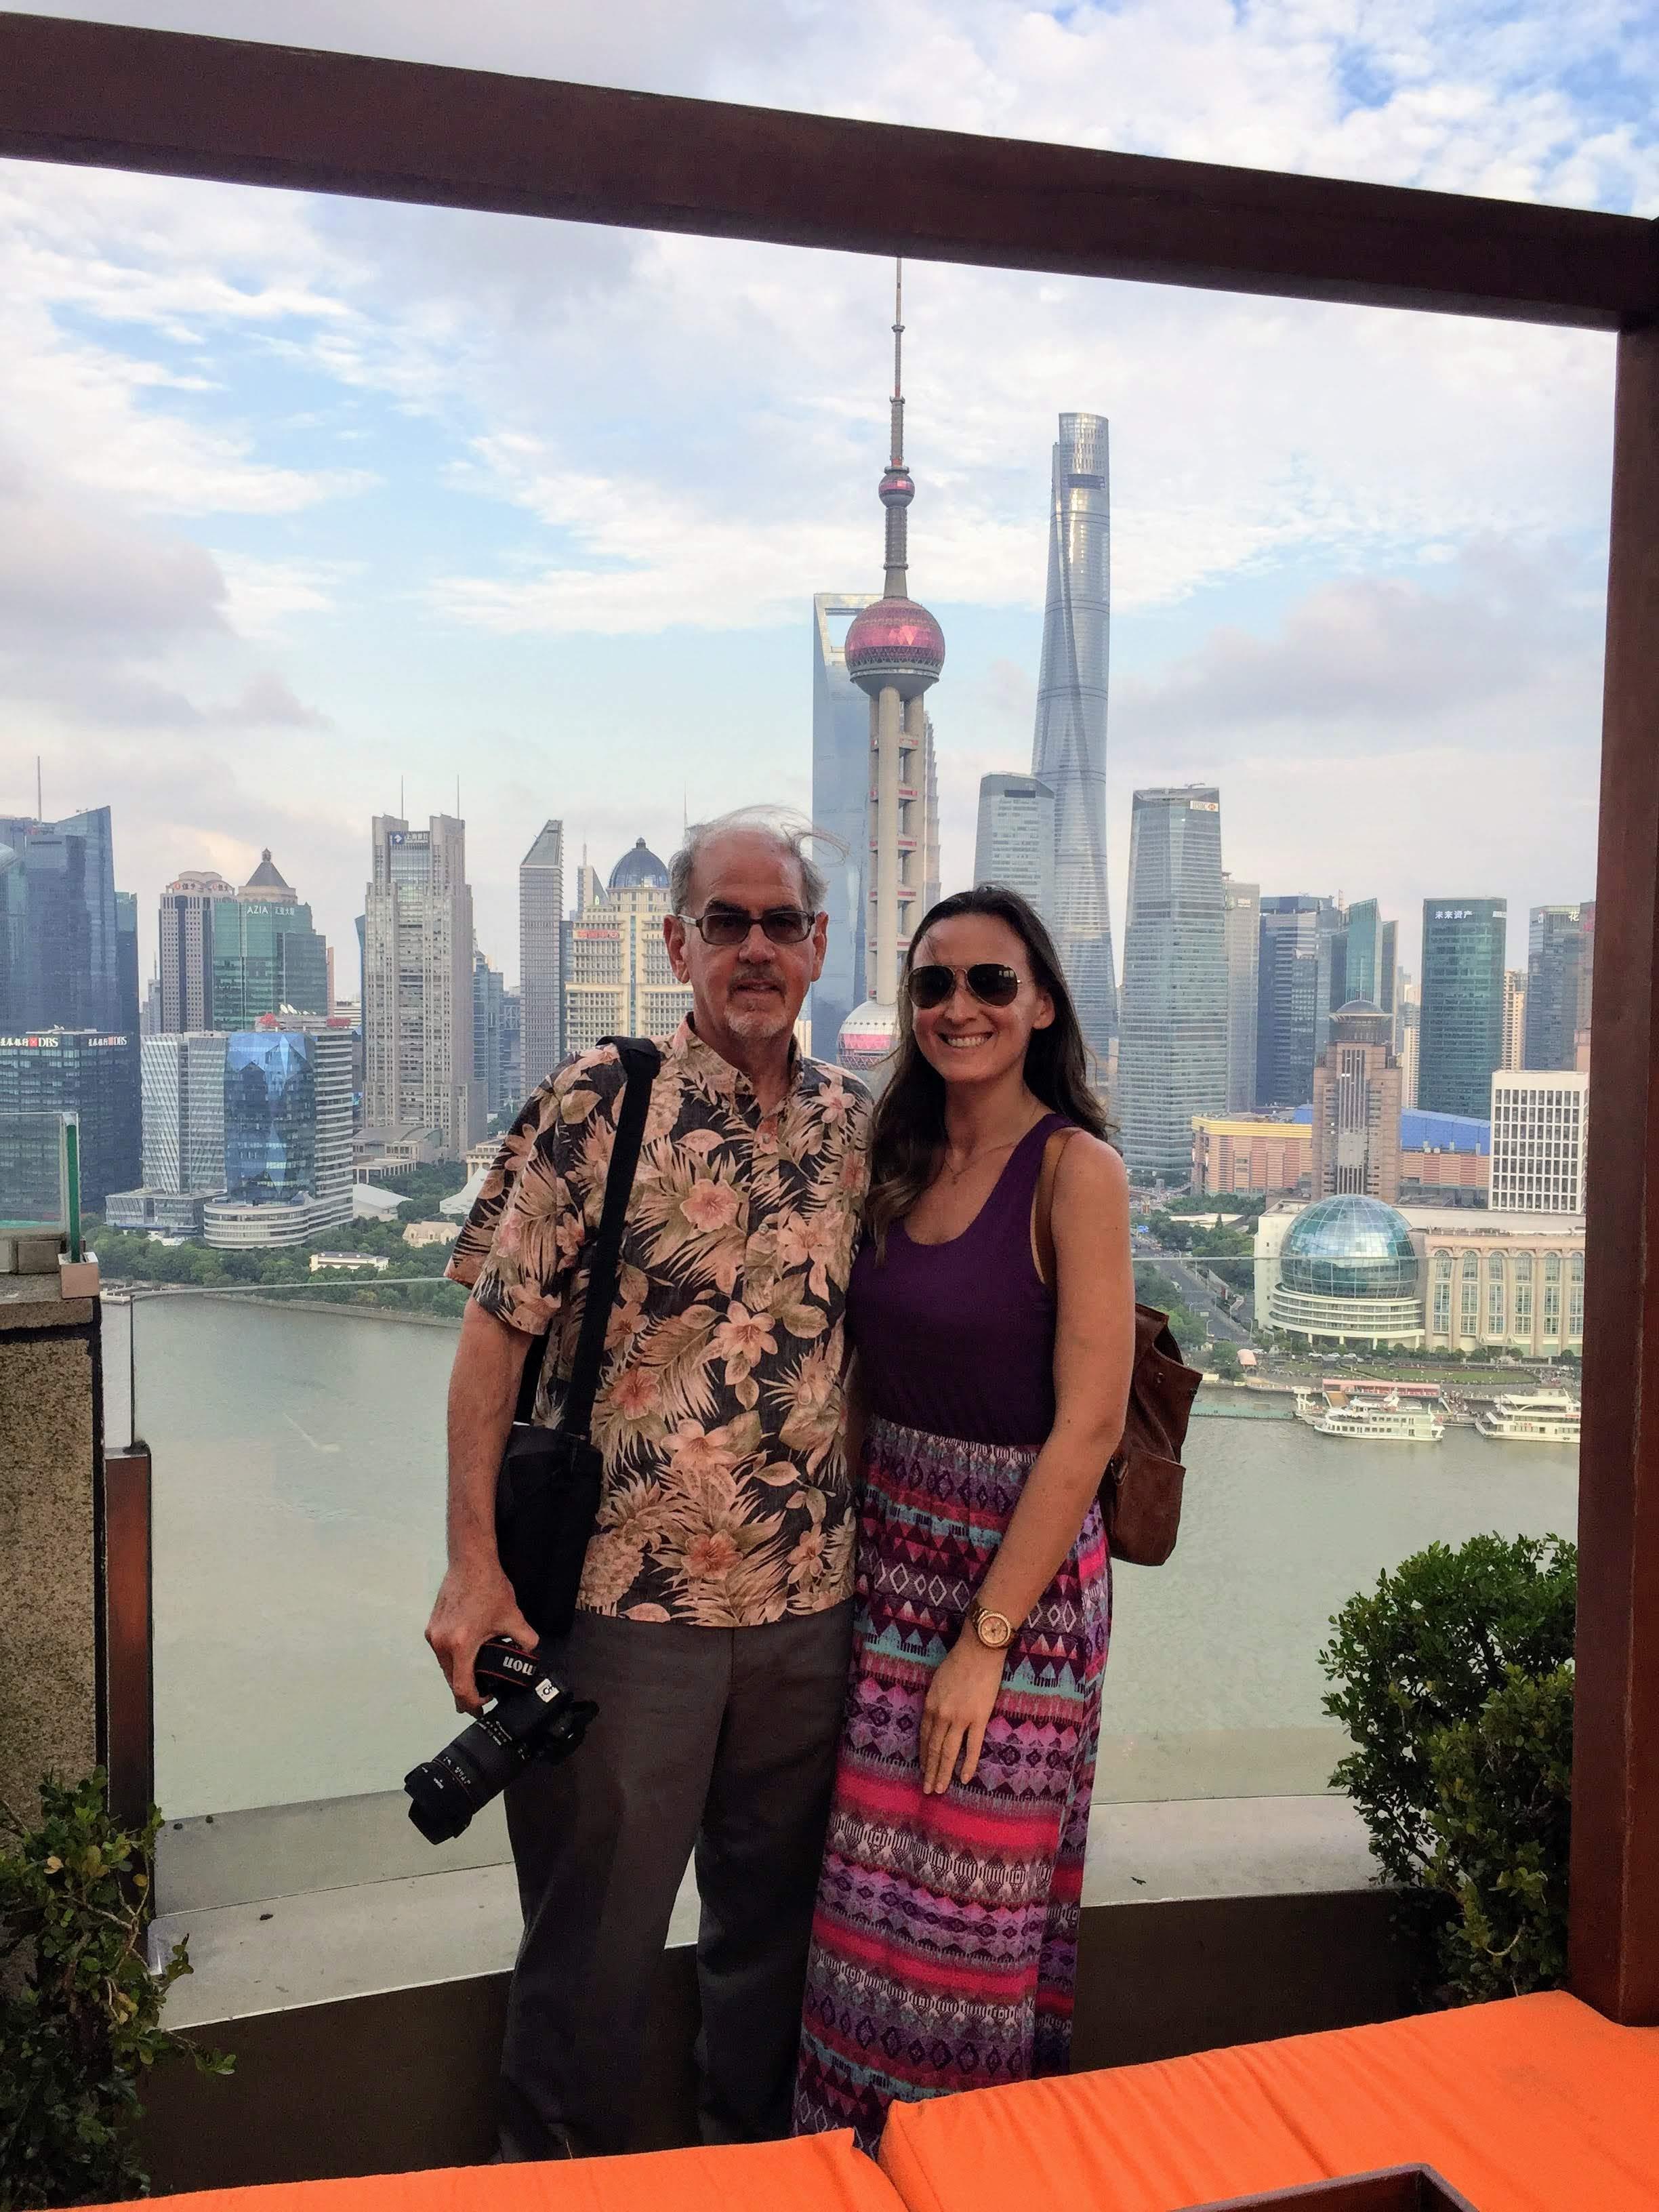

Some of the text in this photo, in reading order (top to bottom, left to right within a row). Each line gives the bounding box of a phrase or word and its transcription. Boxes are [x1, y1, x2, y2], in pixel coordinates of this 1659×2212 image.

[247, 905, 268, 914] AZIA
[1568, 911, 1580, 922] 花
[38, 1037, 58, 1047] DBS
[113, 1036, 127, 1046] DBS
